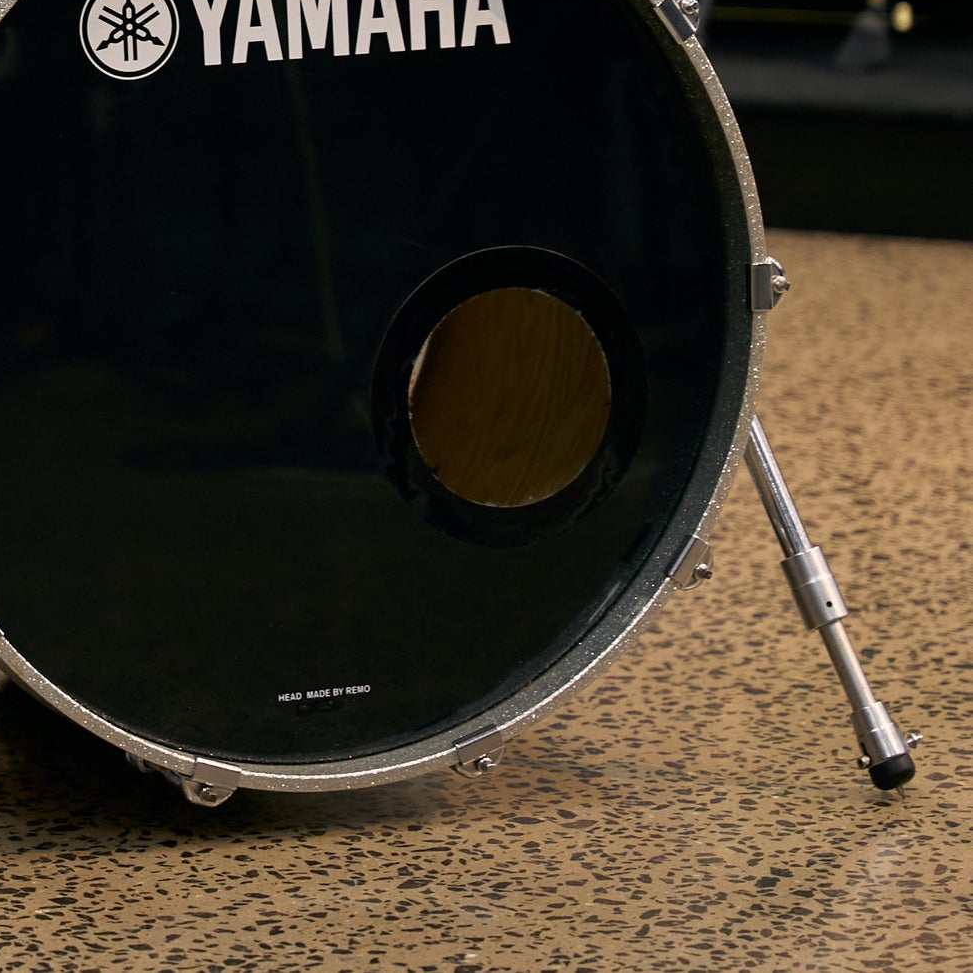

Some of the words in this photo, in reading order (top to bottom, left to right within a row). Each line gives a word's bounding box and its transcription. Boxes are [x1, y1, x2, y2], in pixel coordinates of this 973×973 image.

[278, 692, 303, 702] HEAD
[306, 689, 331, 699] MADE
[332, 687, 344, 696] BY
[345, 685, 371, 695] REMO
